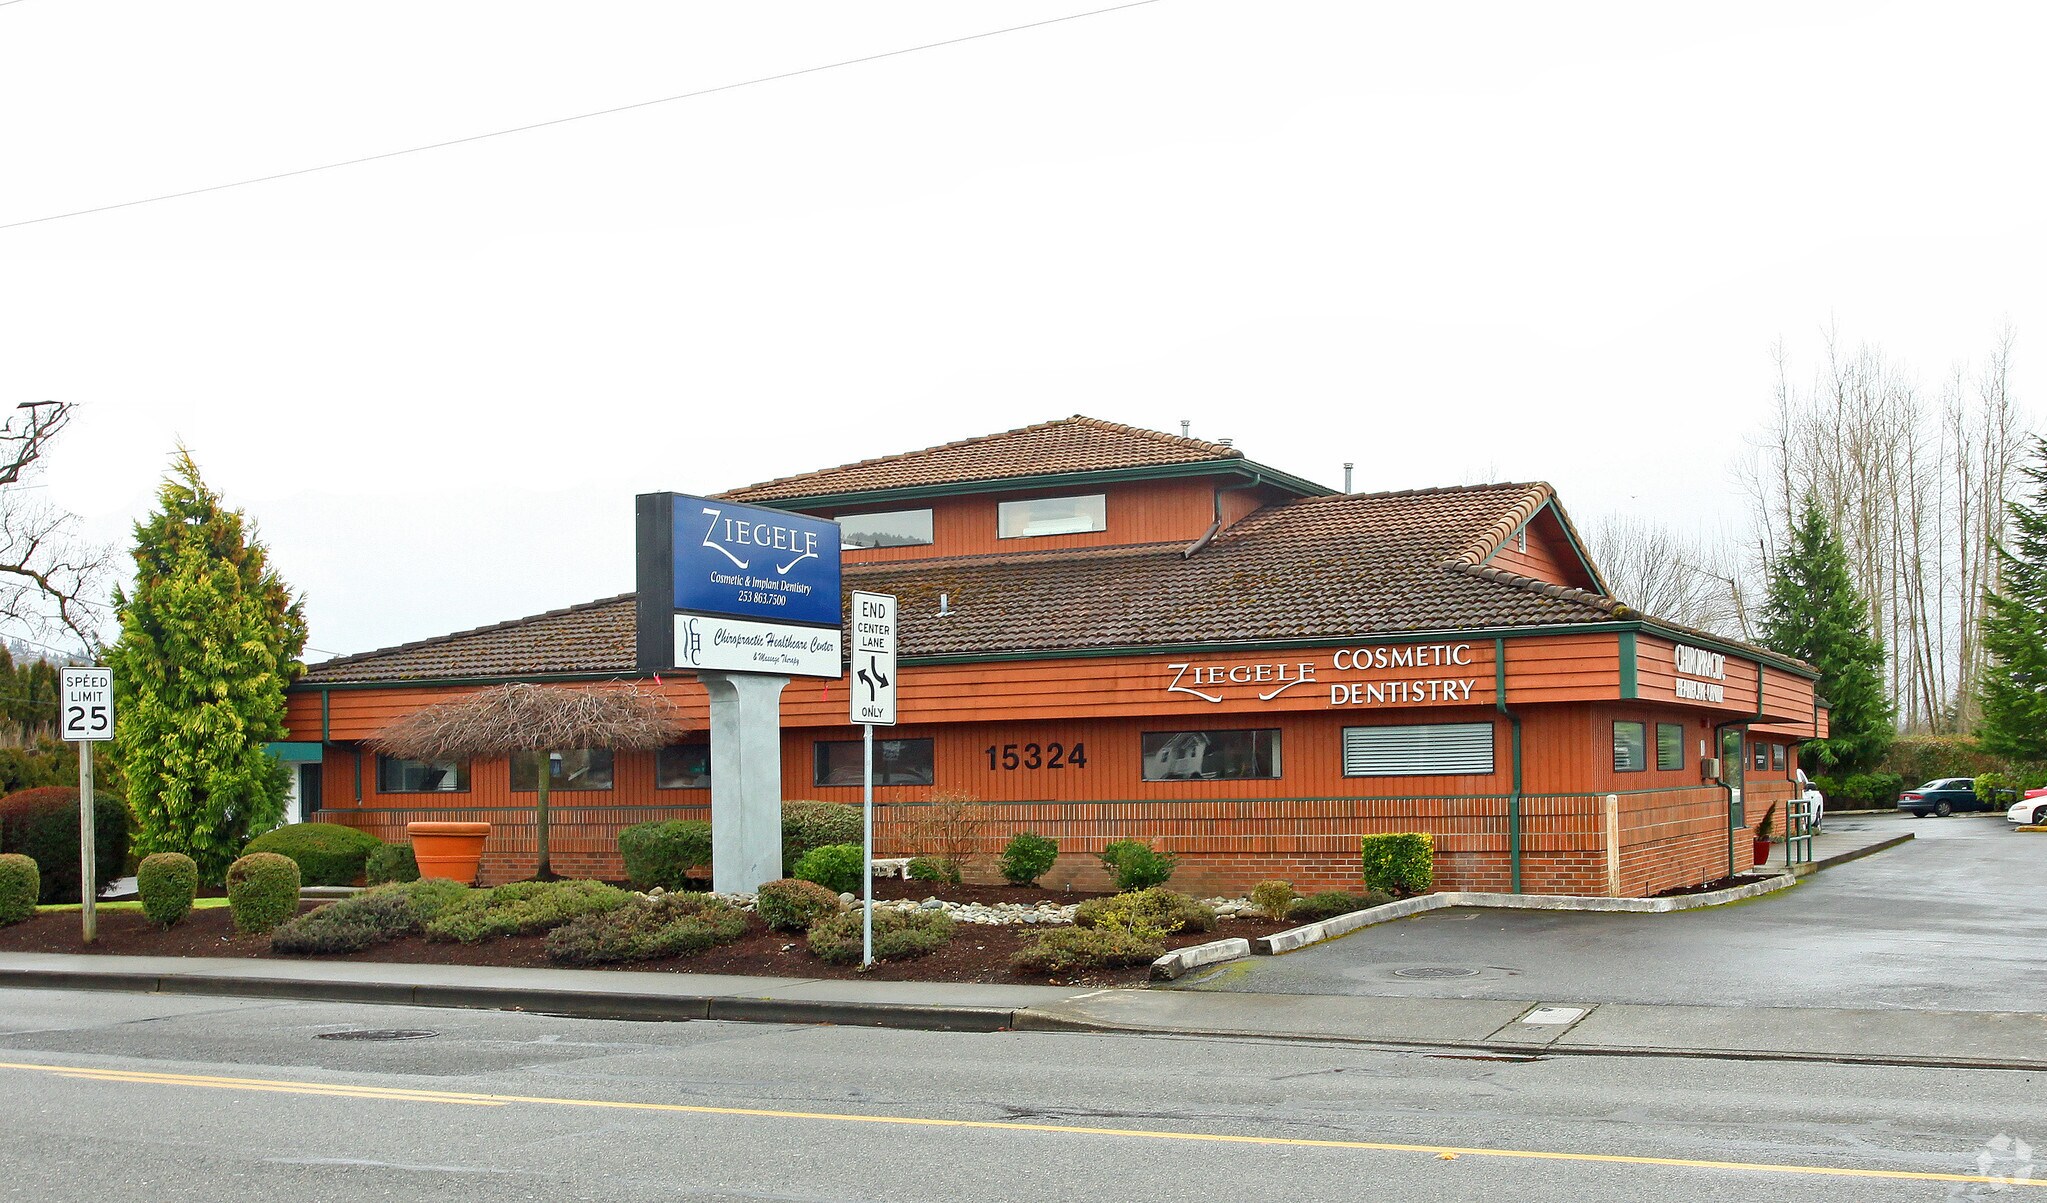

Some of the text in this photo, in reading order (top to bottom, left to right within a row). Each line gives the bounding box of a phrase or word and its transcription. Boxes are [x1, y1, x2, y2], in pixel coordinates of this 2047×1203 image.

[702, 507, 819, 575] ZIEGELE
[710, 571, 812, 596] Cosmetic & Implant Dentistry
[738, 590, 787, 606] 253 863.7500
[862, 601, 886, 619] END
[714, 628, 834, 654] Chiropractic Healthcare Center
[857, 622, 890, 635] CENTER
[862, 636, 885, 648] LANE
[1333, 644, 1472, 671] COSMETIC
[66, 676, 108, 688] SPEED
[1167, 662, 1317, 703] ZIEGELE
[1330, 679, 1476, 706] DENTISTRY
[70, 691, 103, 702] LIMIT
[68, 706, 108, 731] 25
[861, 706, 884, 718] ONLY
[985, 742, 1087, 770] 15324
